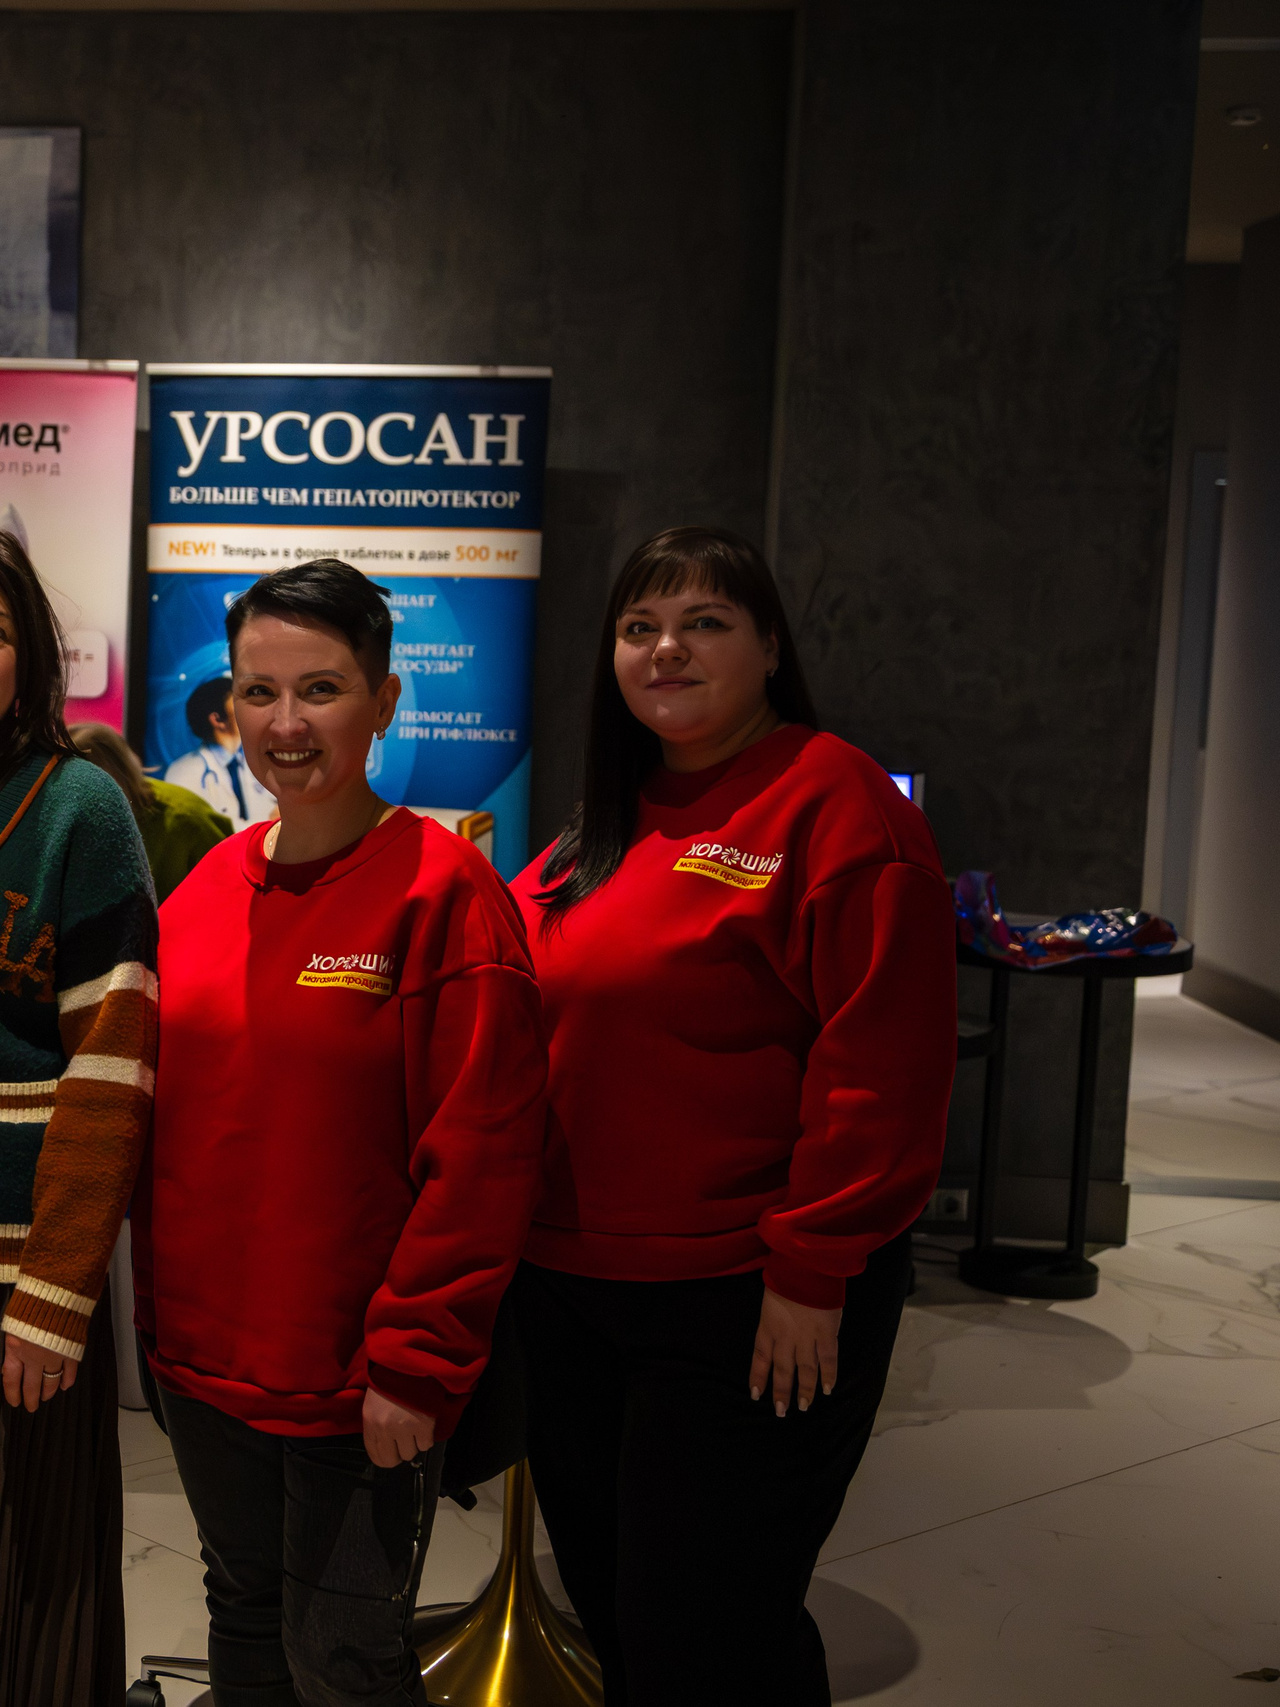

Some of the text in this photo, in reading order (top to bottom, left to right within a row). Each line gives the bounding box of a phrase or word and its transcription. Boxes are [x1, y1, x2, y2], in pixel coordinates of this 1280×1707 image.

[169, 410, 526, 478] УРСОСАН
[169, 486, 521, 509] БОЛЬШЕ ЧЕМ ГЕПАТОПРОТЕКТОР
[169, 541, 519, 562] NEW! Теперь и в форме таблеток в дозе 500 мг
[400, 710, 483, 725] ПОМОГАЕТ
[398, 726, 518, 742] ПРИ РЕФЛЮКСЕ
